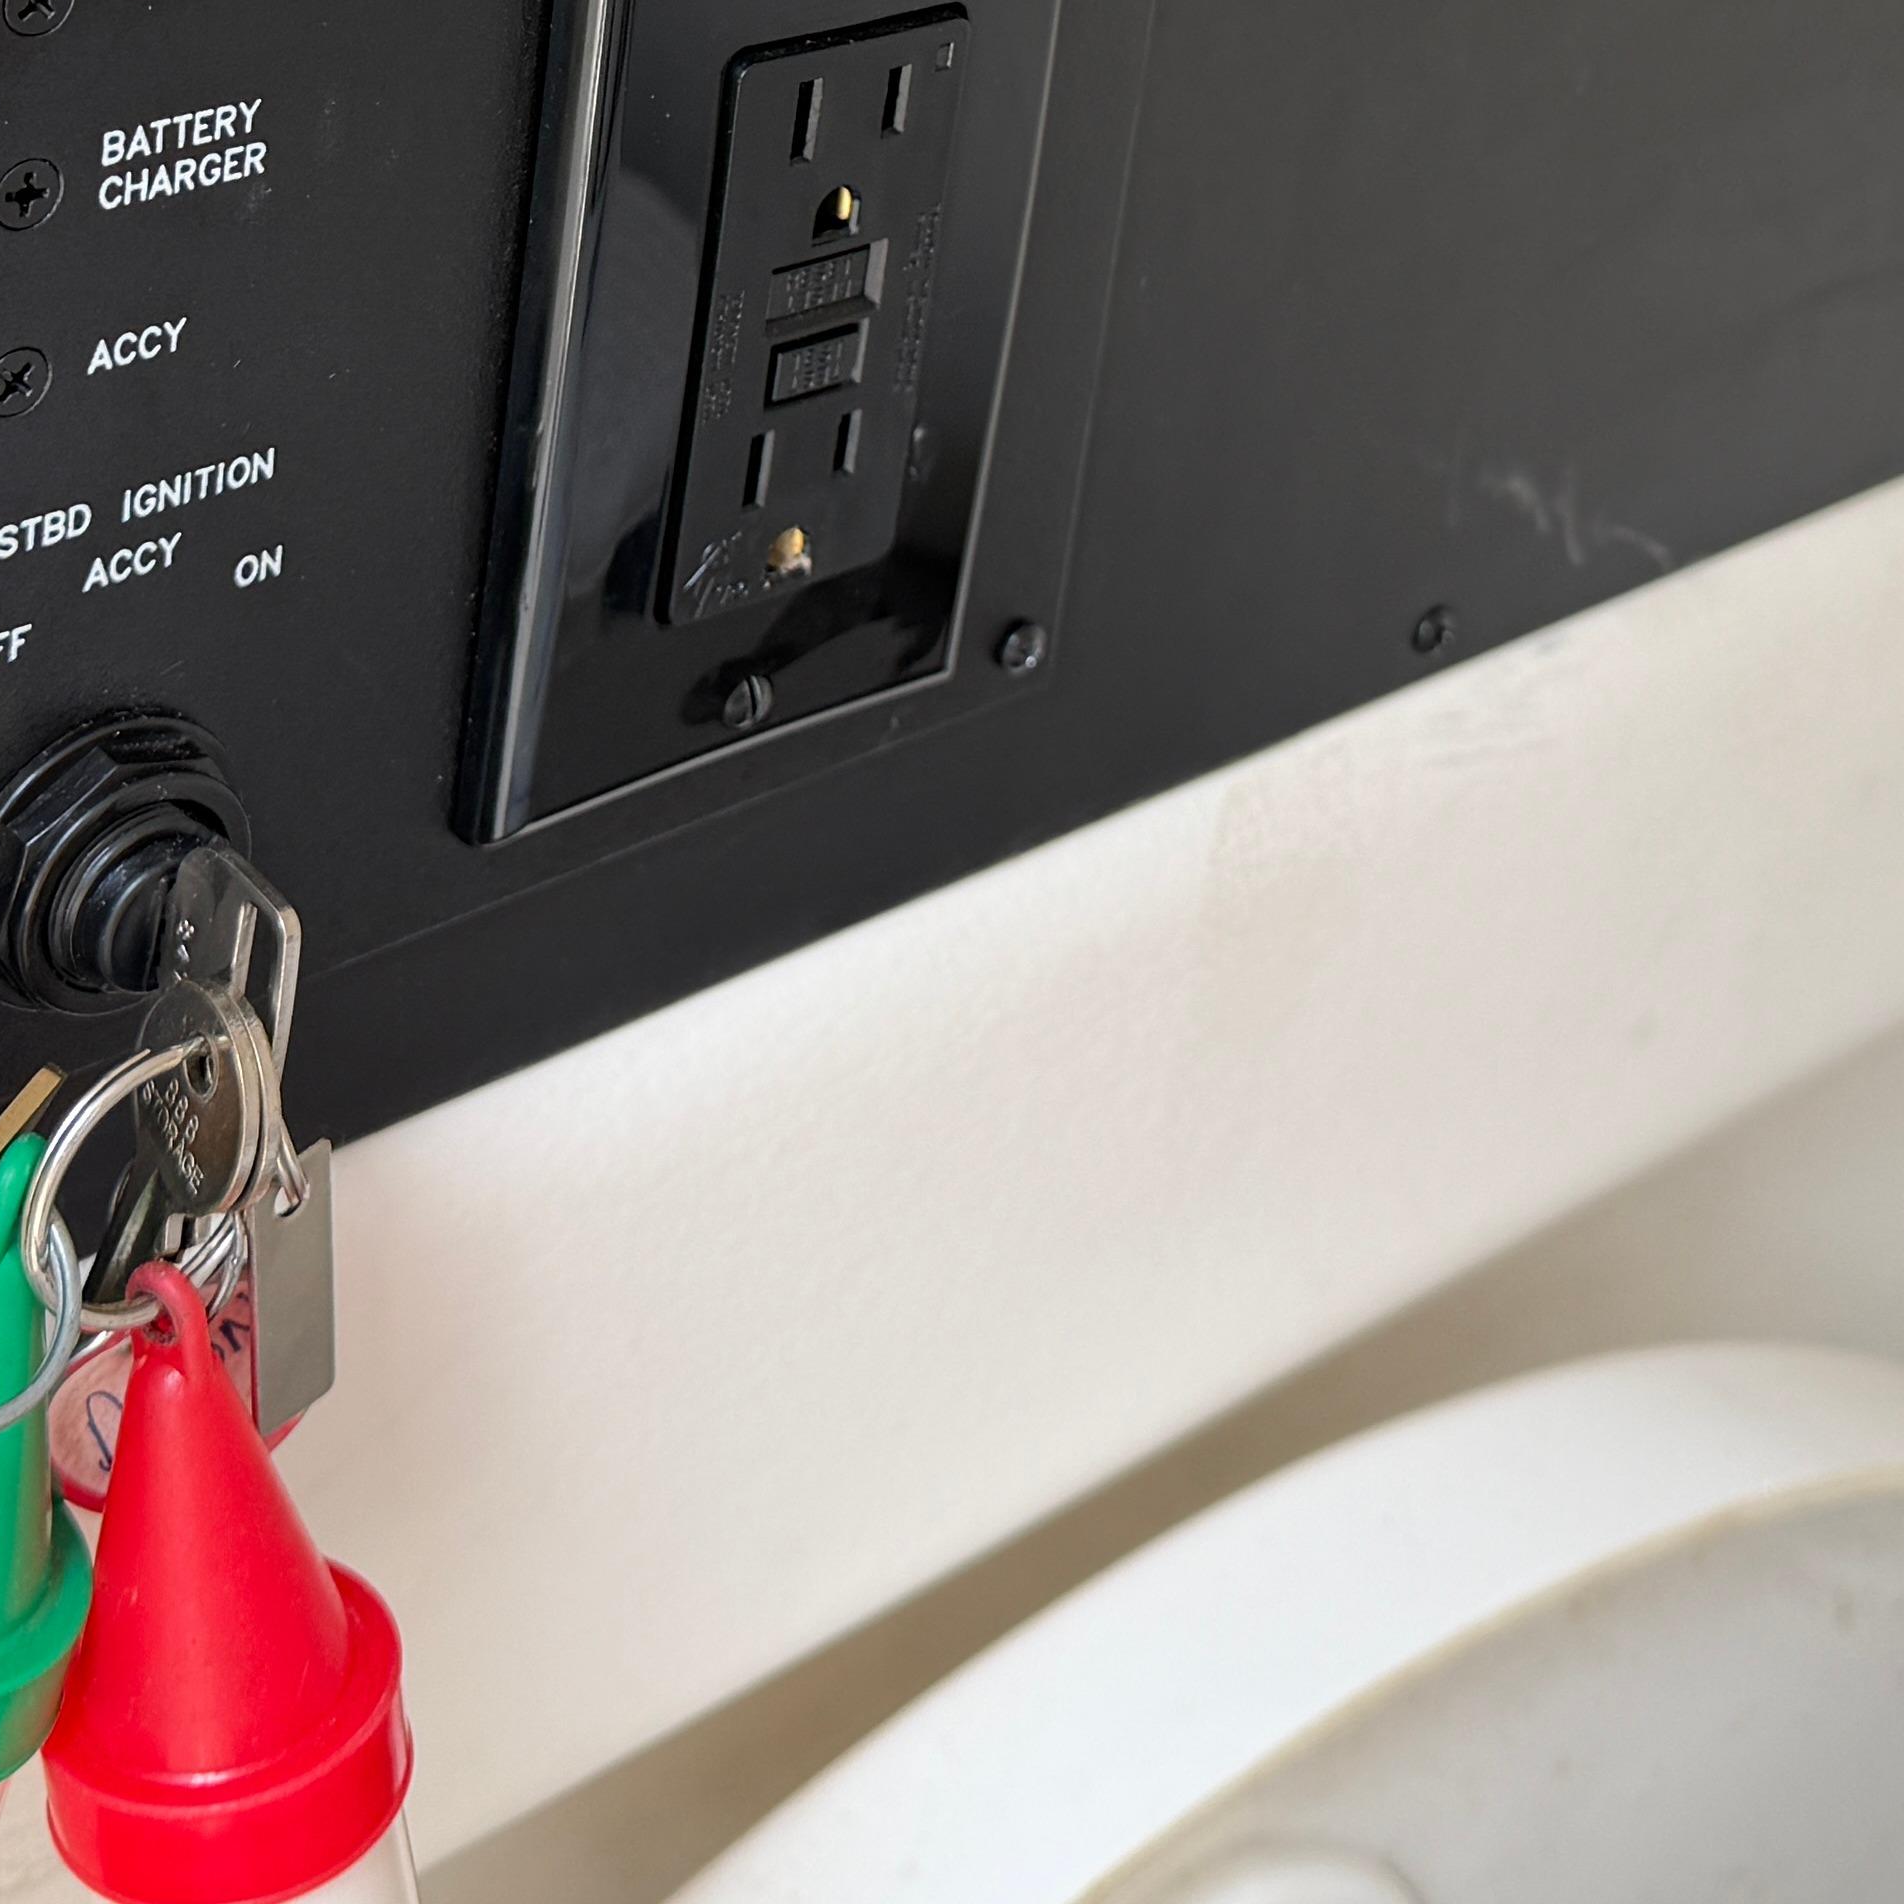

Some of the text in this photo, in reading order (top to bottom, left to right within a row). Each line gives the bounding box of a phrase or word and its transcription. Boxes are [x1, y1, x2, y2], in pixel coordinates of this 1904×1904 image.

[99, 98, 264, 168] BATTERY
[97, 140, 269, 211] CHARGER
[87, 317, 187, 375] ACCY
[122, 447, 275, 523] IGNITION
[82, 531, 183, 594] ACCY
[234, 544, 283, 587] ON
